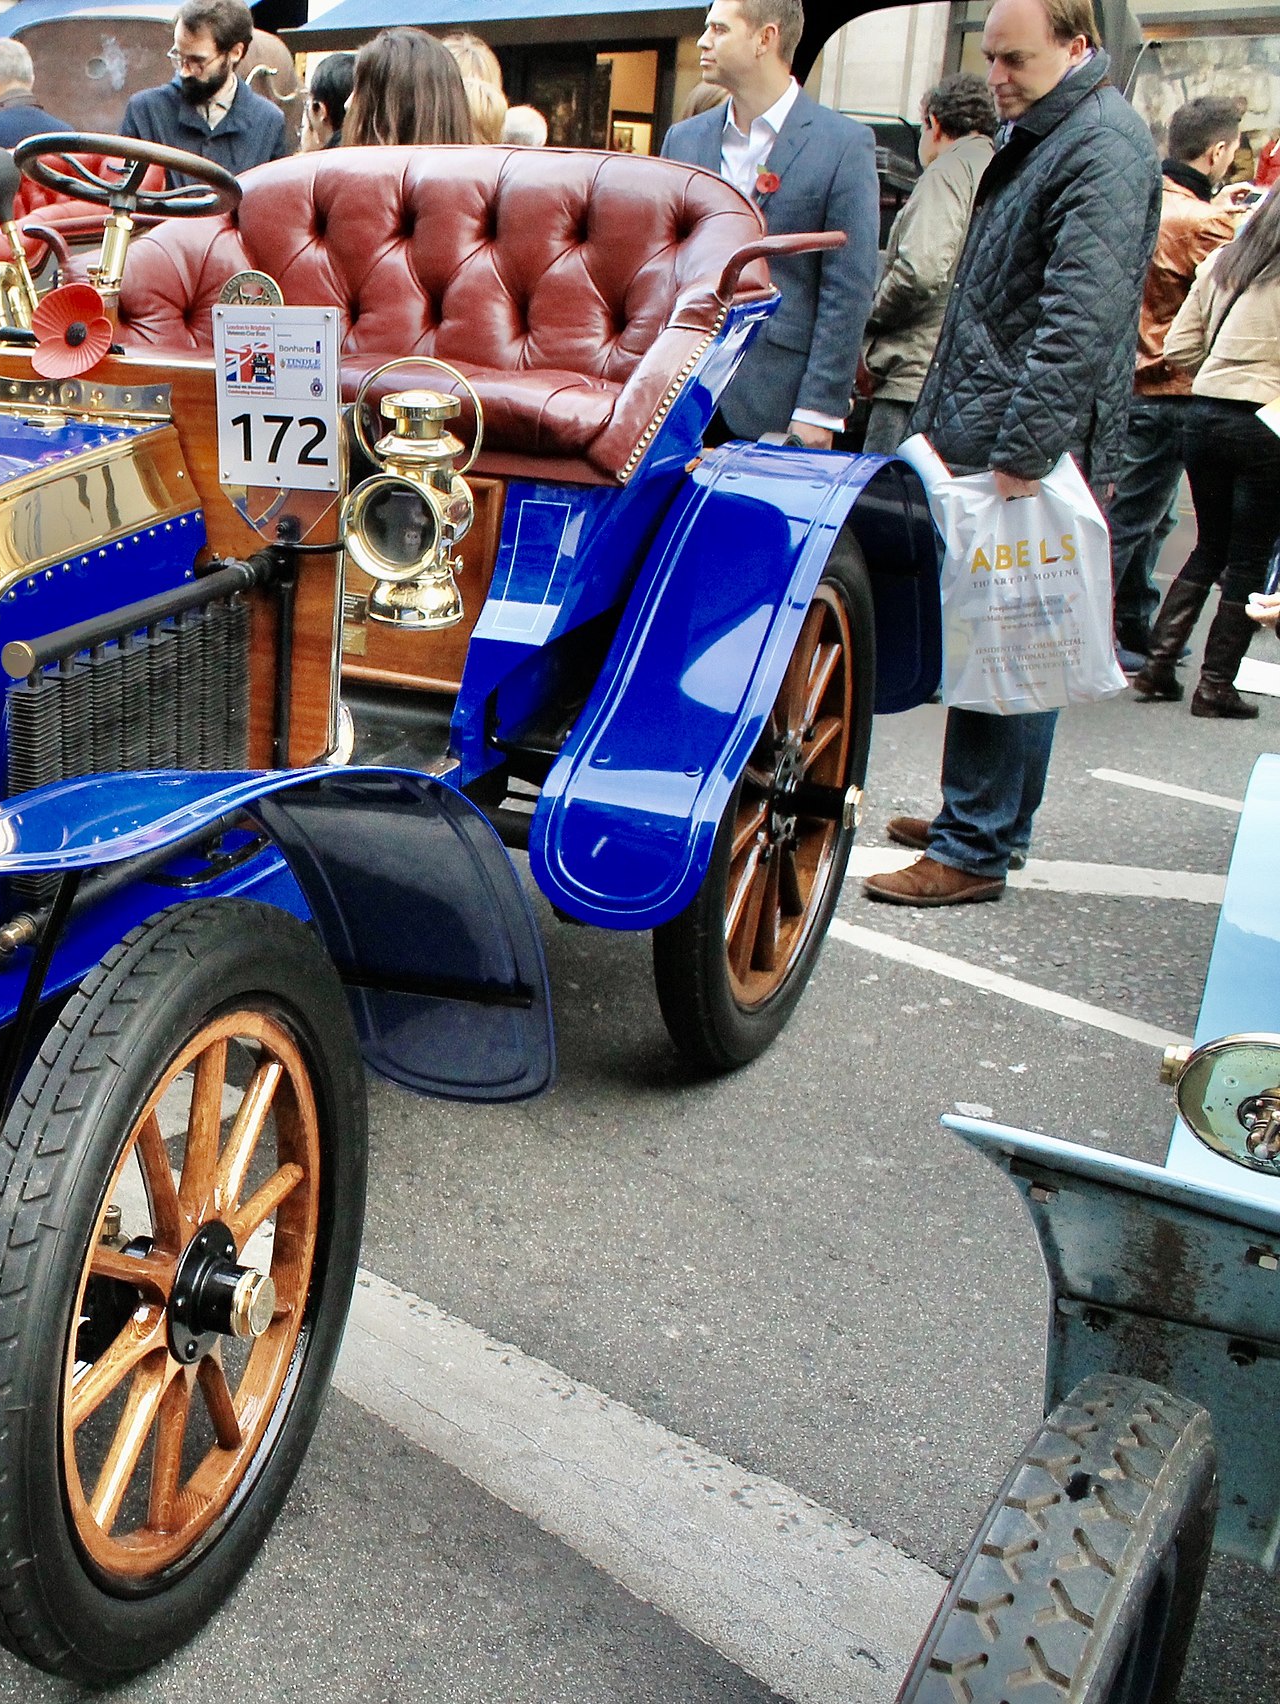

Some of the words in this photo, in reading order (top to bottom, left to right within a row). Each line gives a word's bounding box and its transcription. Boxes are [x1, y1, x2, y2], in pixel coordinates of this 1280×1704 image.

[279, 345, 314, 353] Bonhams
[231, 413, 328, 466] 172
[970, 534, 1076, 574] ABELS
[1033, 568, 1079, 580] MOVING
